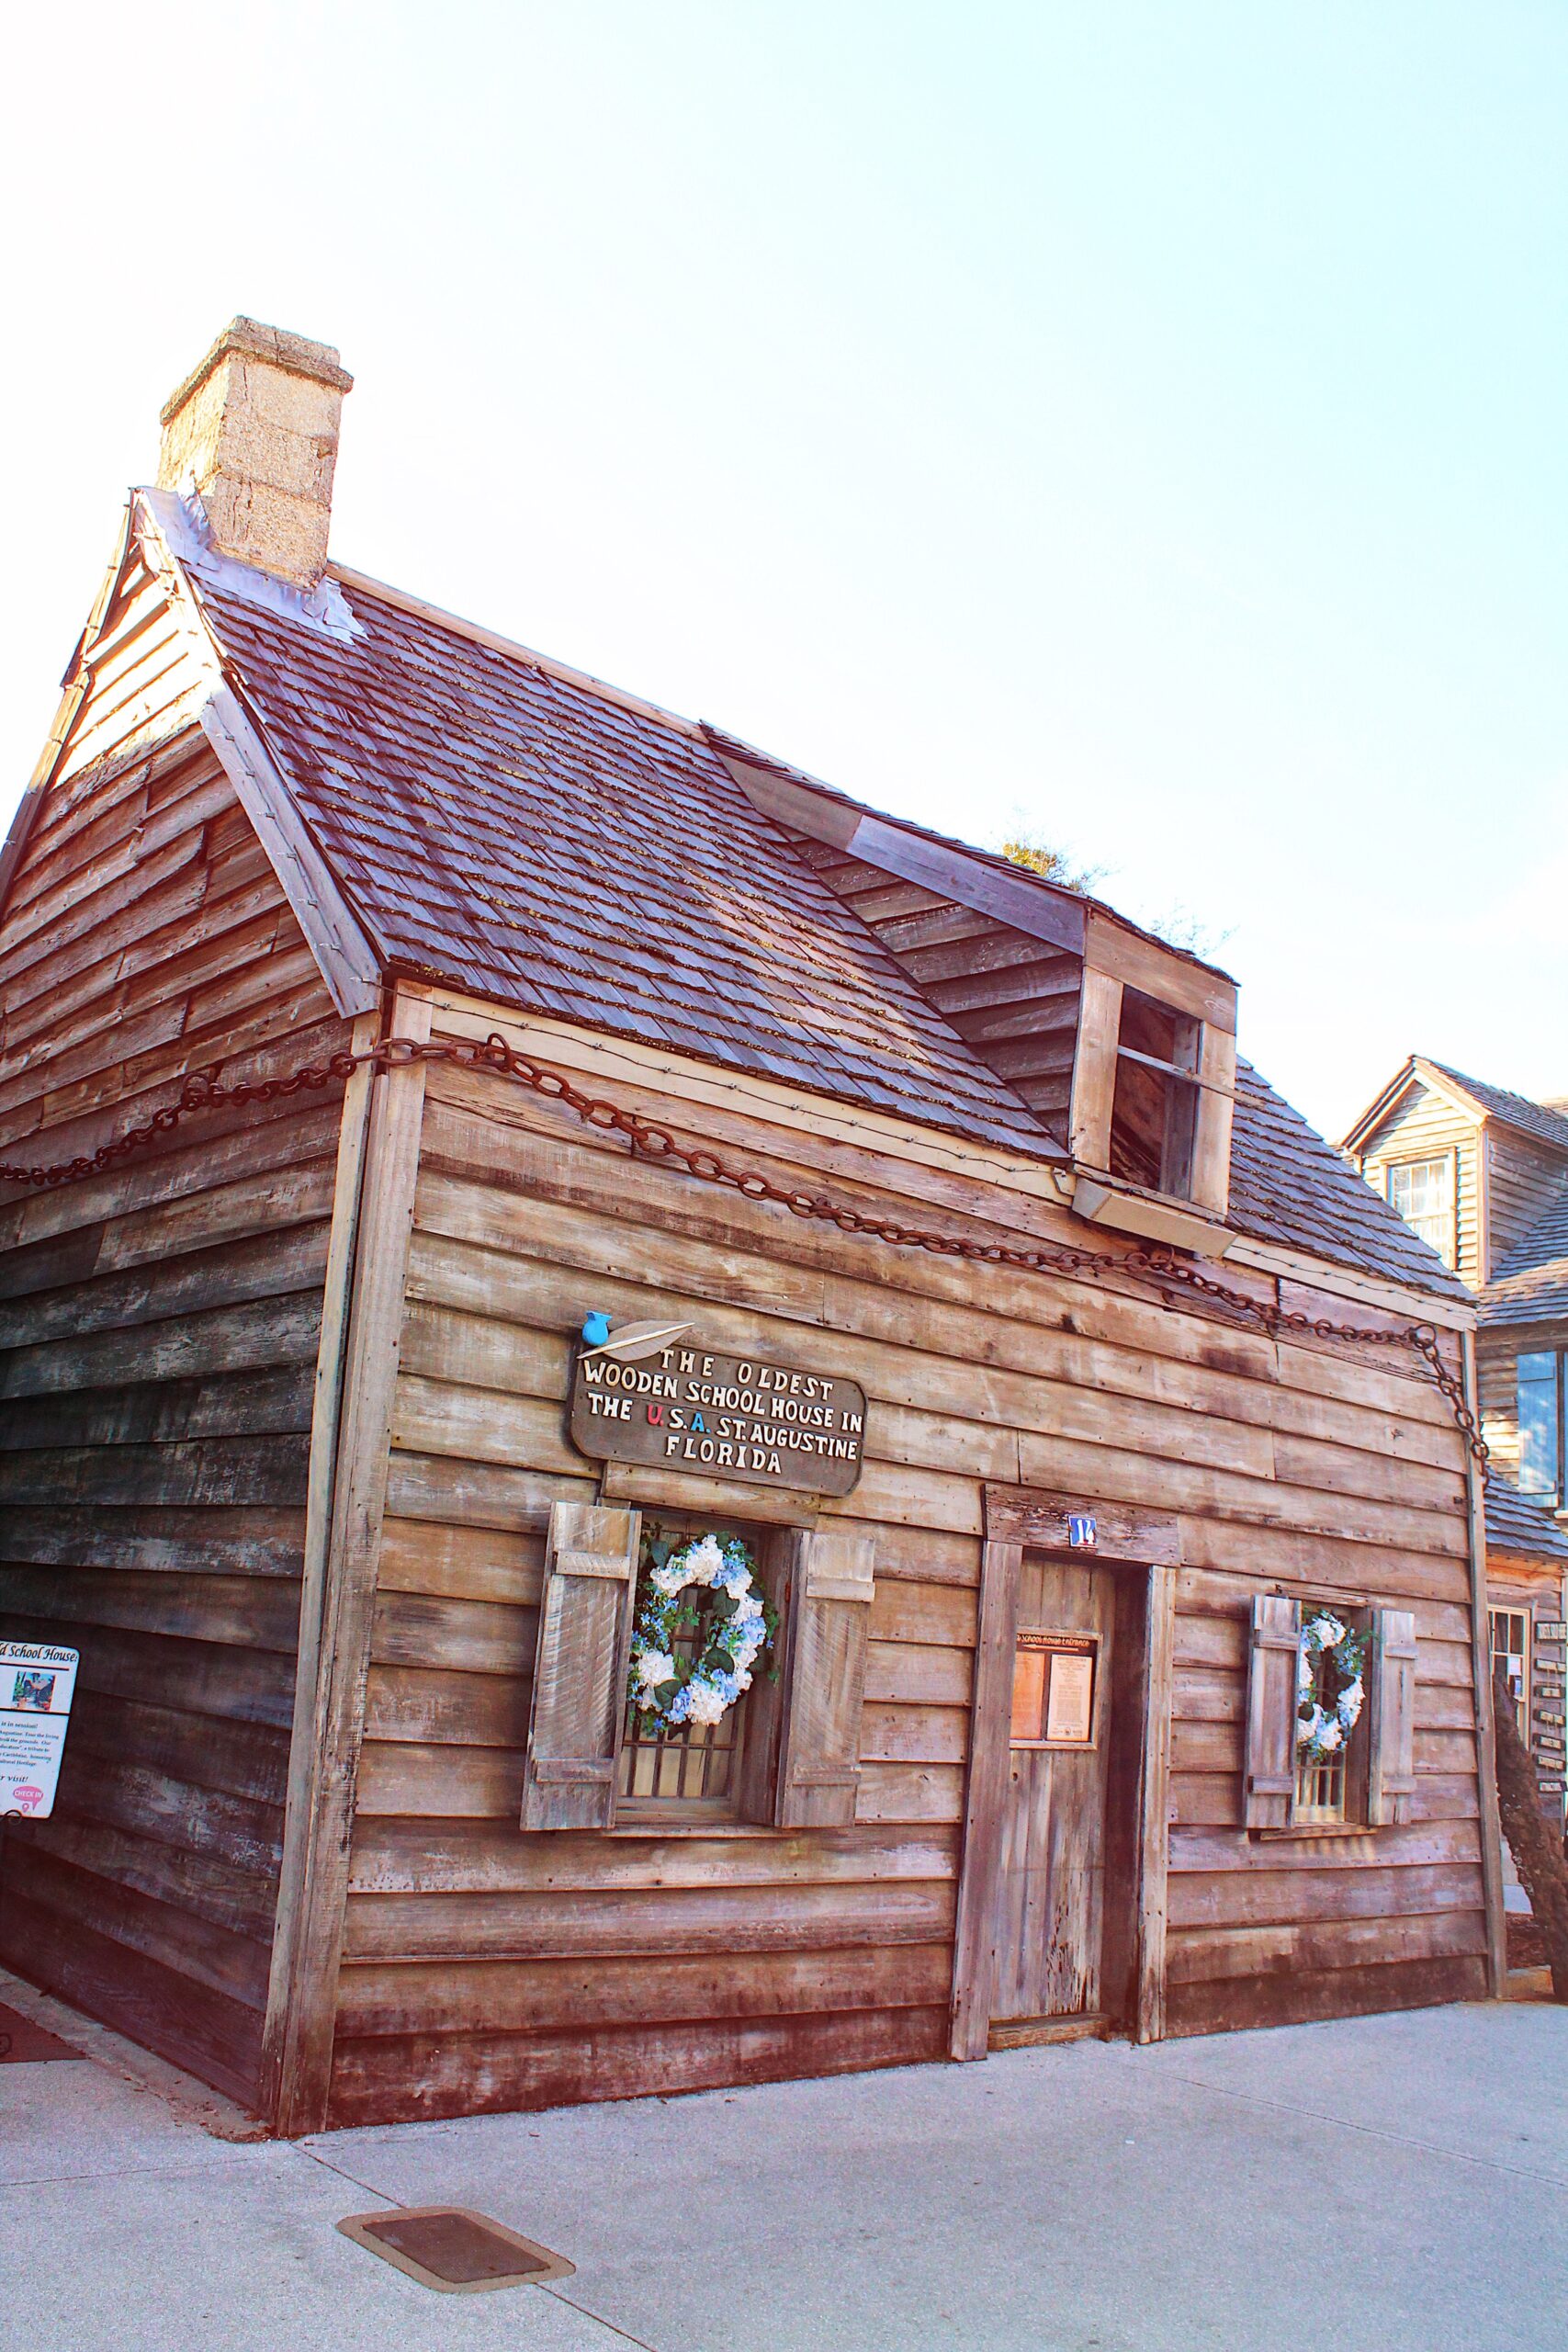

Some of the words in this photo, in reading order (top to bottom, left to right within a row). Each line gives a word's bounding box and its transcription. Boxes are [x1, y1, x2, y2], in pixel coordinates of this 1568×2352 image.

[582, 1360, 679, 1399] WOODEN
[684, 1381, 765, 1416] SCHOOL
[771, 1398, 833, 1428] HOUSE
[840, 1411, 863, 1433] IN
[660, 1349, 714, 1377] THE
[738, 1363, 833, 1401] OLDEST
[587, 1392, 633, 1420] THE
[750, 1424, 859, 1460] AUGUSTINE
[665, 1435, 783, 1474] FLORIDA
[8, 1645, 45, 1659] School
